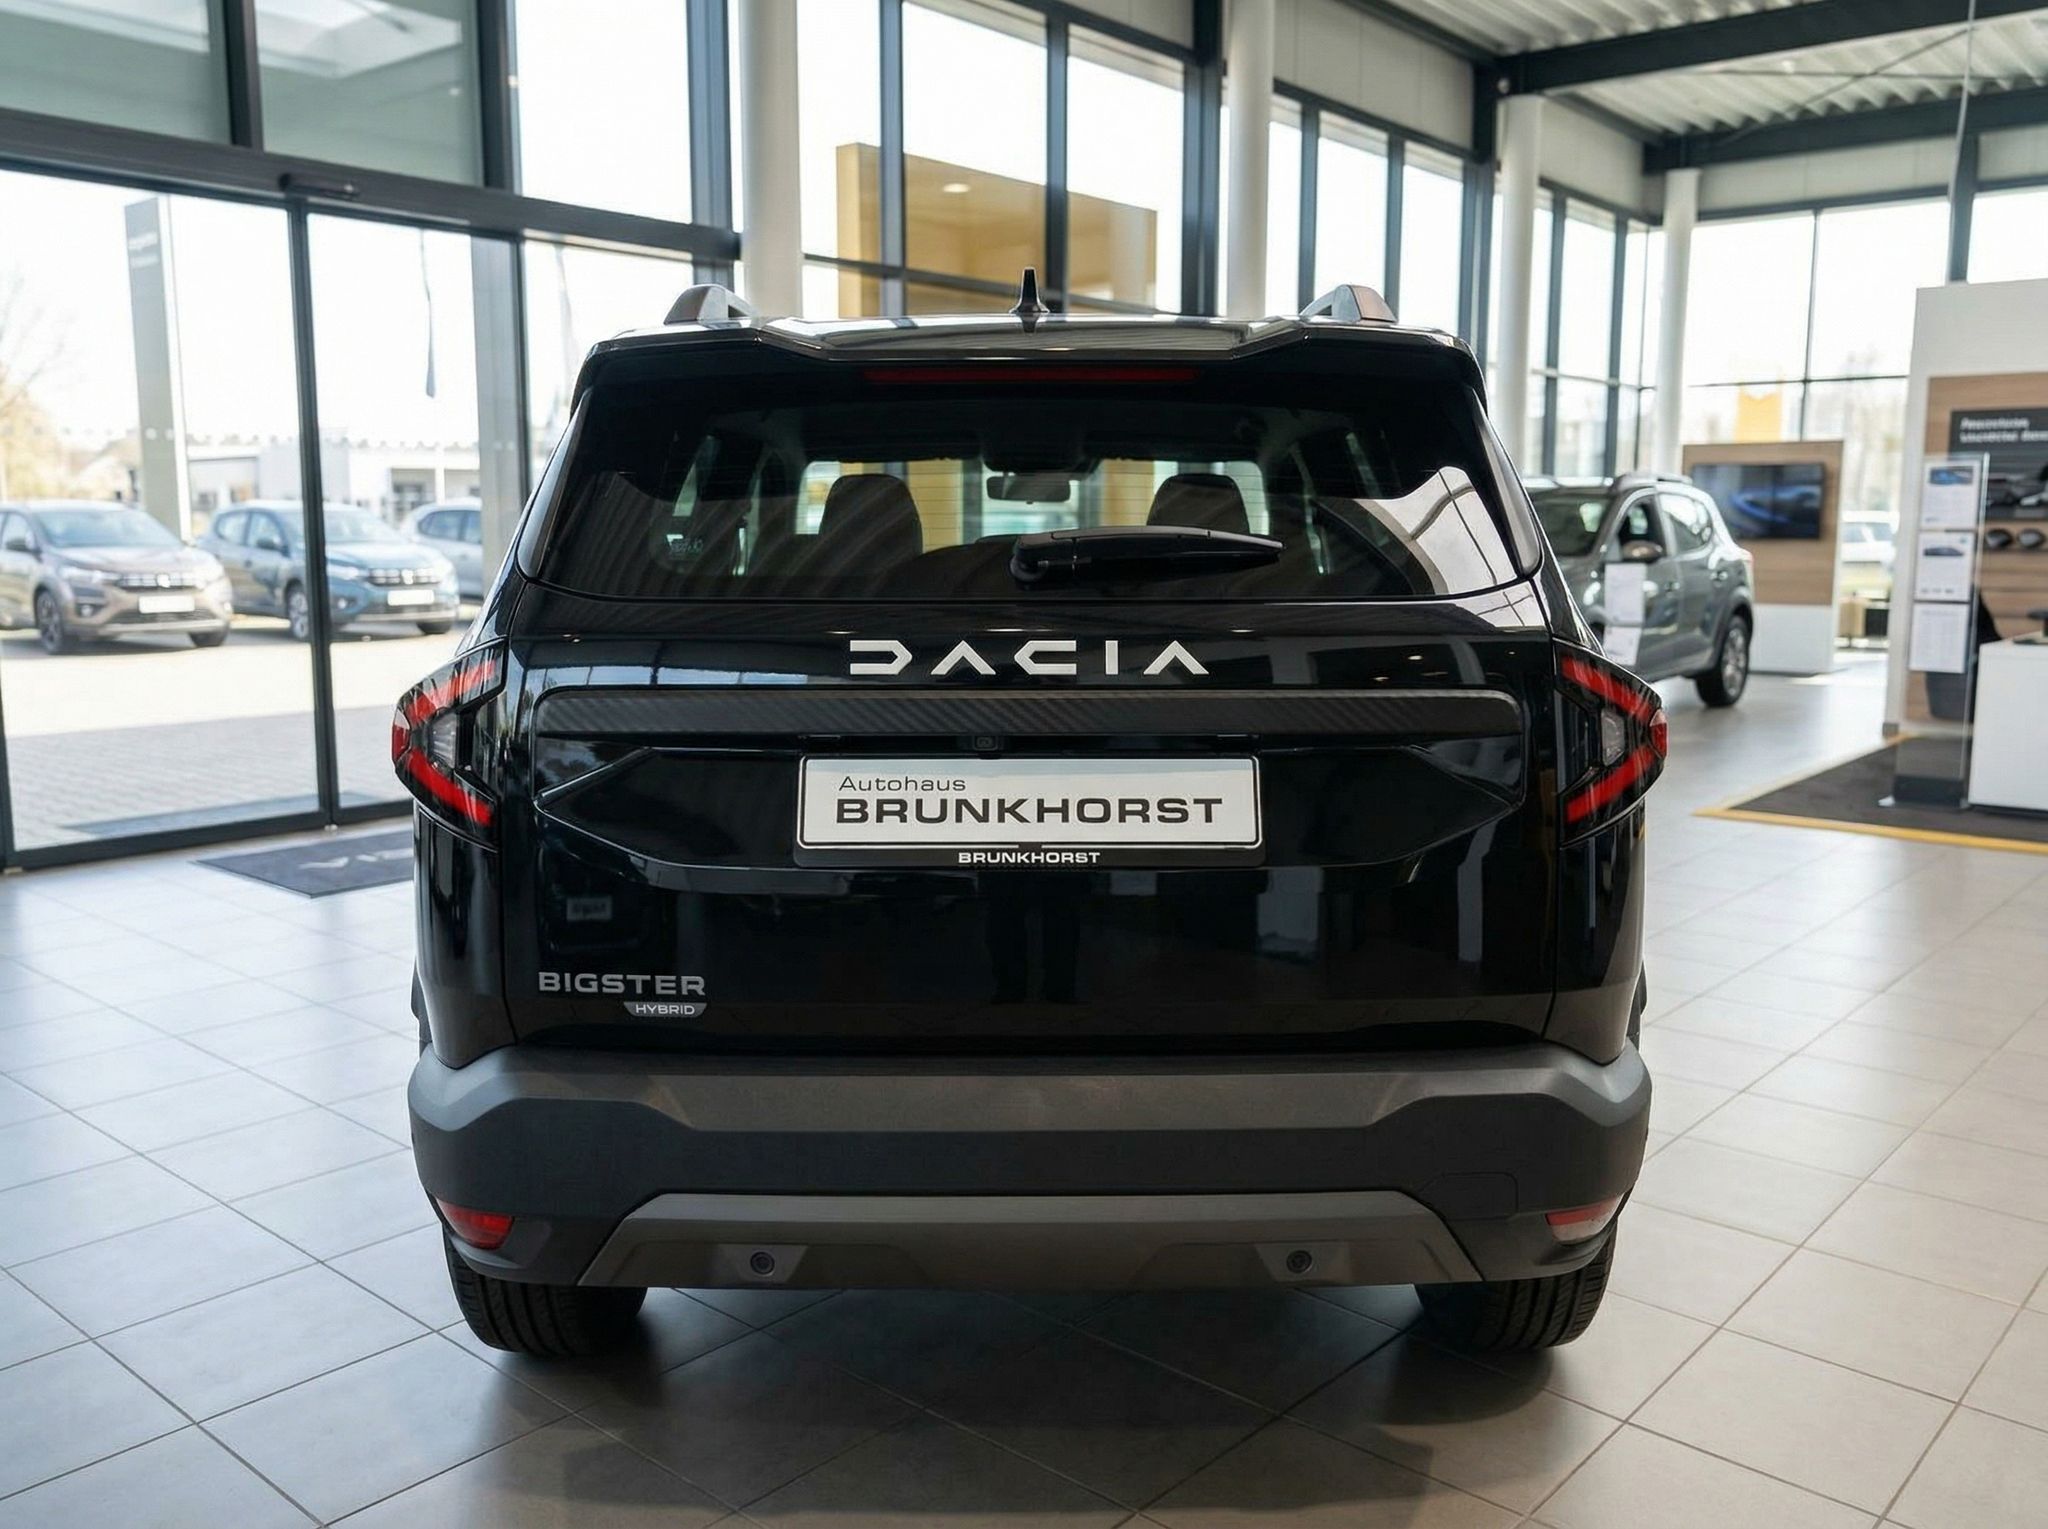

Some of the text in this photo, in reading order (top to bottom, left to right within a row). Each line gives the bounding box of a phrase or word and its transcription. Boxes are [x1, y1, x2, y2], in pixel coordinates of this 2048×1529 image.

[849, 639, 1210, 675] DACIA
[838, 776, 966, 792] Autohaus
[836, 798, 1223, 824] BRUNKHORST
[958, 852, 1101, 864] BRUNKHORST
[538, 972, 706, 996] BIGSTER
[635, 1003, 695, 1015] HYBRID
